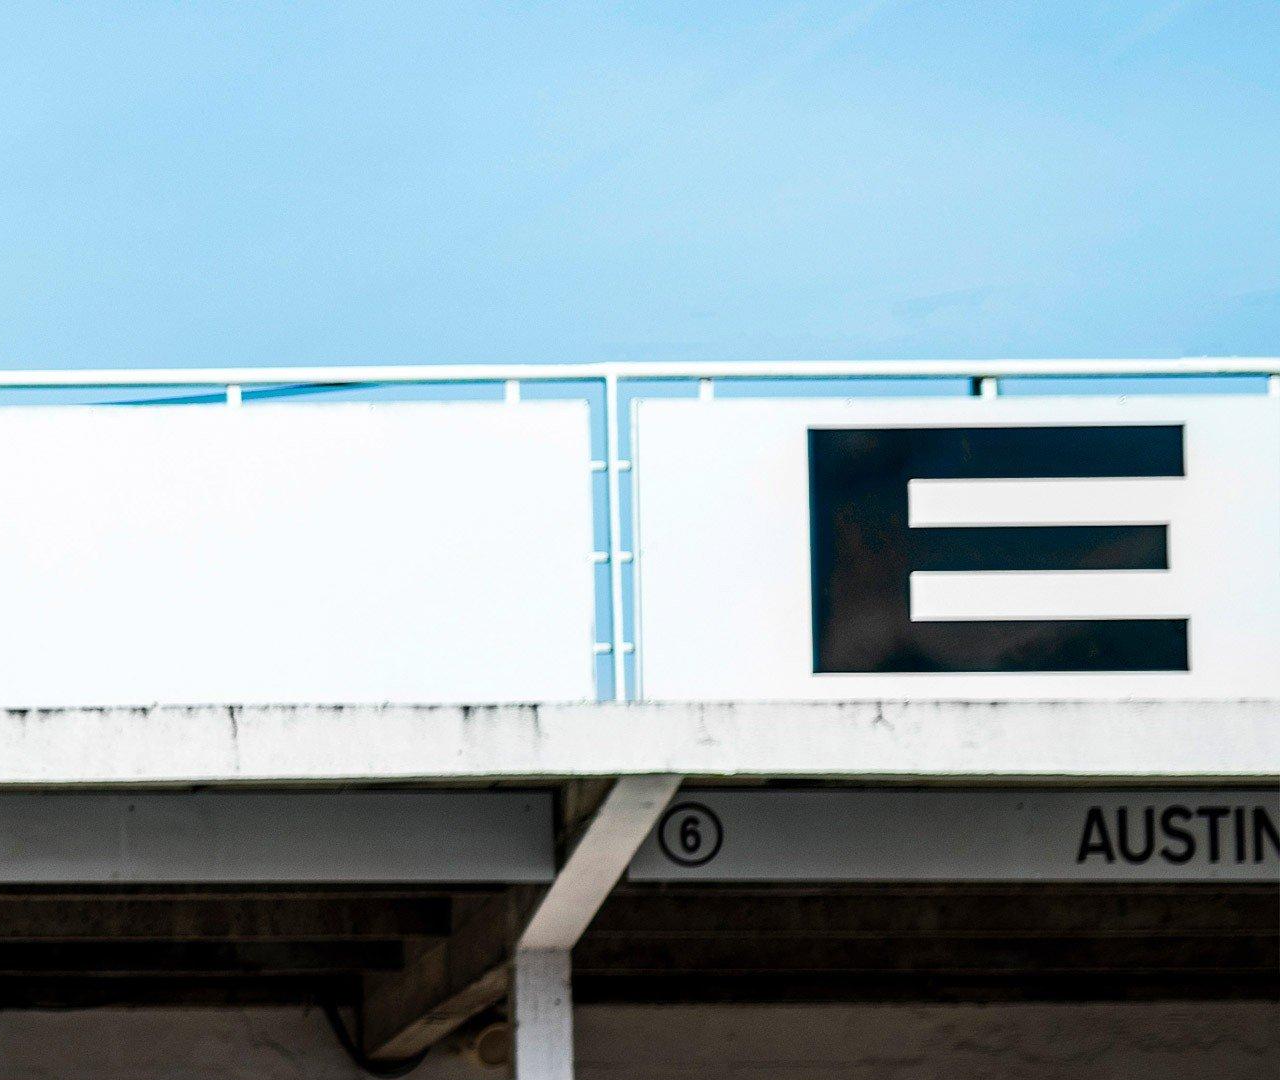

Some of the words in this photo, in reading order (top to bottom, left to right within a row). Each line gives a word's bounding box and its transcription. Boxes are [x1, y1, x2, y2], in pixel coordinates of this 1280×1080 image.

[808, 425, 1190, 674] E
[678, 814, 702, 855] 6
[1076, 804, 1280, 865] AUSTIN
